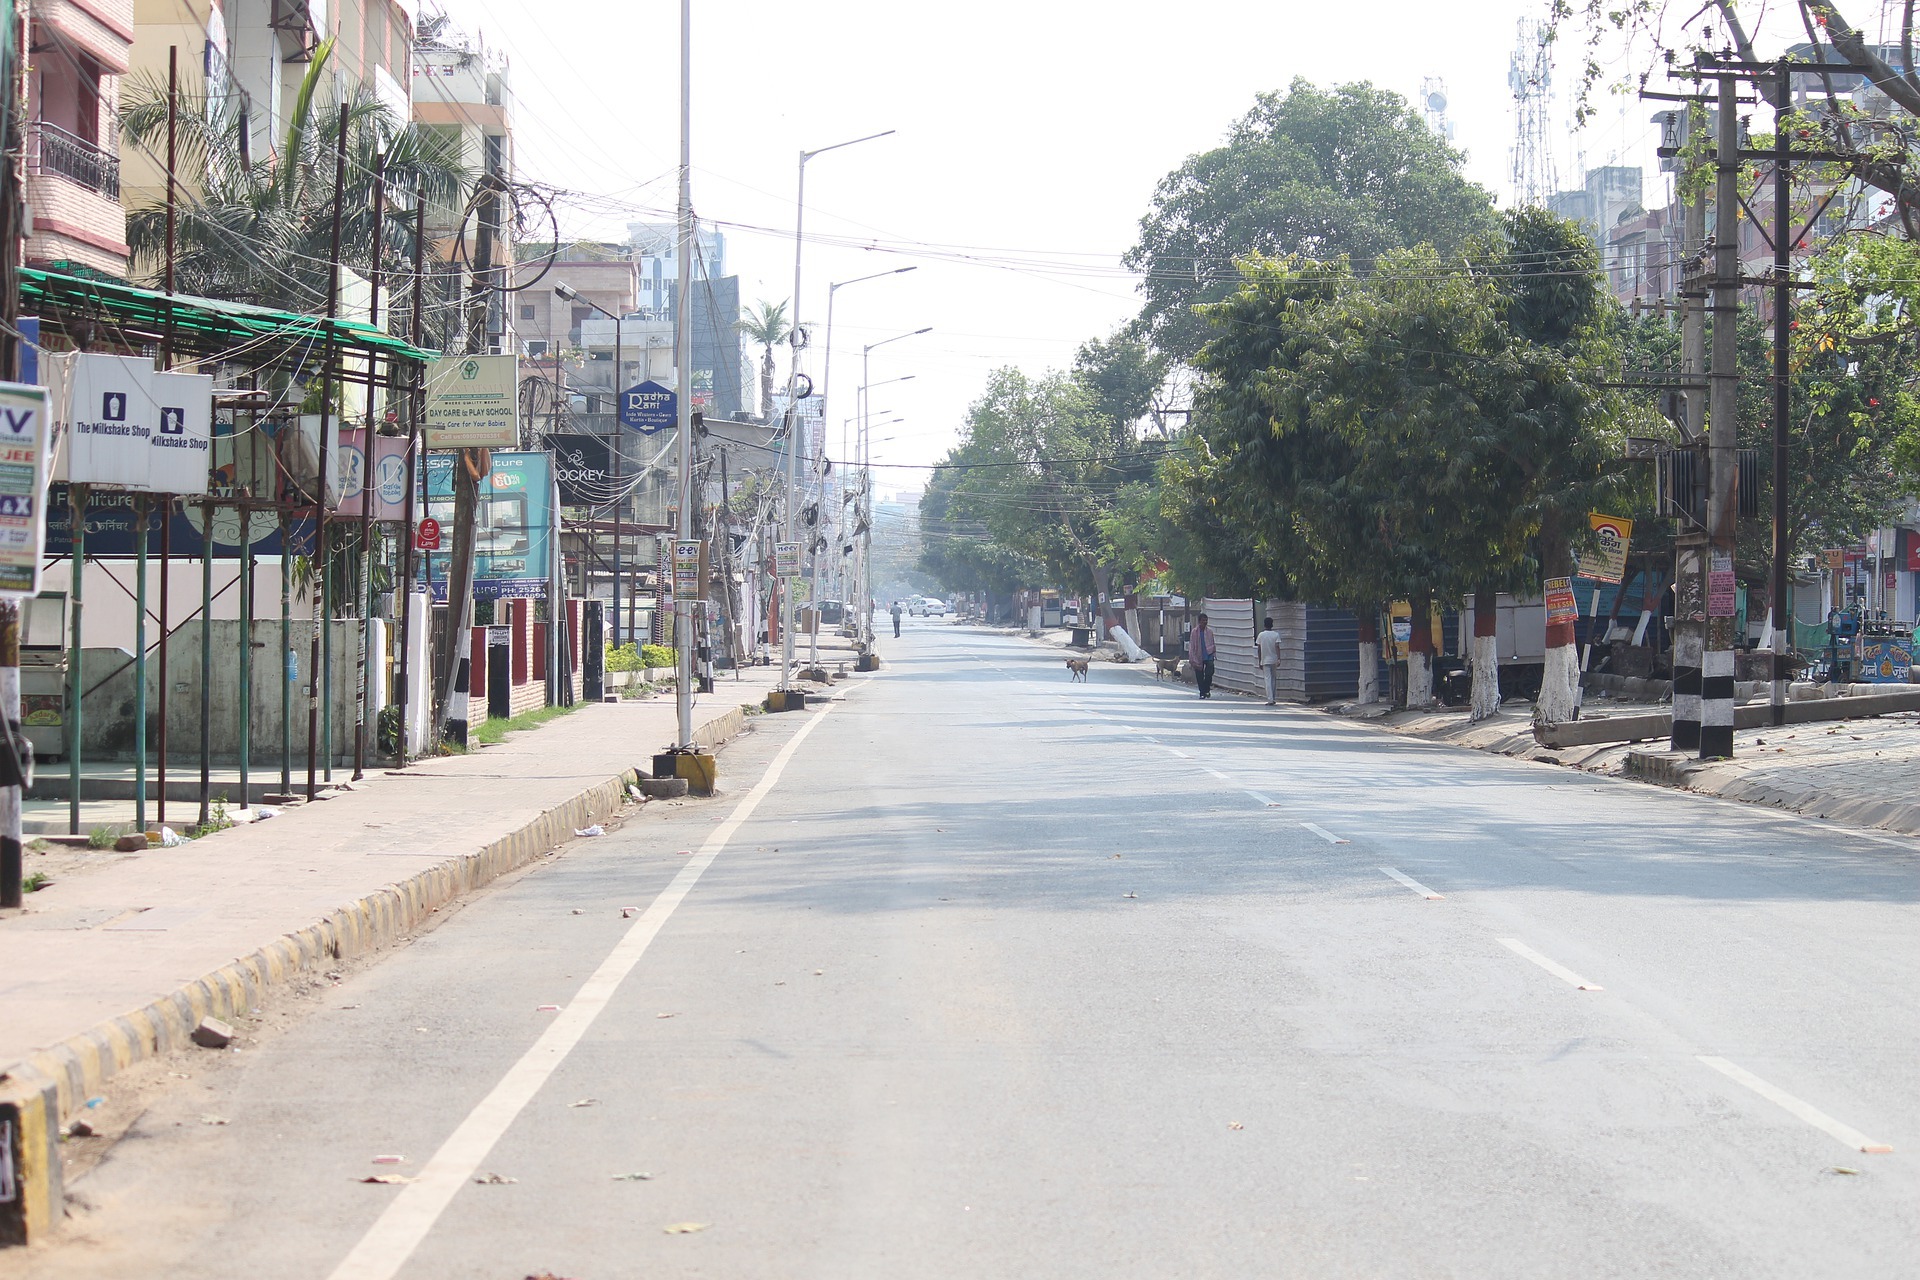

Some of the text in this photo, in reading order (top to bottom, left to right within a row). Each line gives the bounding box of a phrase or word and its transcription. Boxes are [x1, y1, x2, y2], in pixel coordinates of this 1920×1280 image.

[628, 392, 671, 407] Radha
[430, 409, 442, 417] DAY
[443, 409, 460, 417] CARE
[469, 408, 485, 416] PLAY
[486, 408, 512, 416] SCHOOL
[488, 419, 506, 427] Babies
[77, 422, 150, 439] The Milkshake Shop
[189, 438, 208, 451] Shop
[57, 491, 133, 507] Funiture
[677, 545, 699, 555] eev
